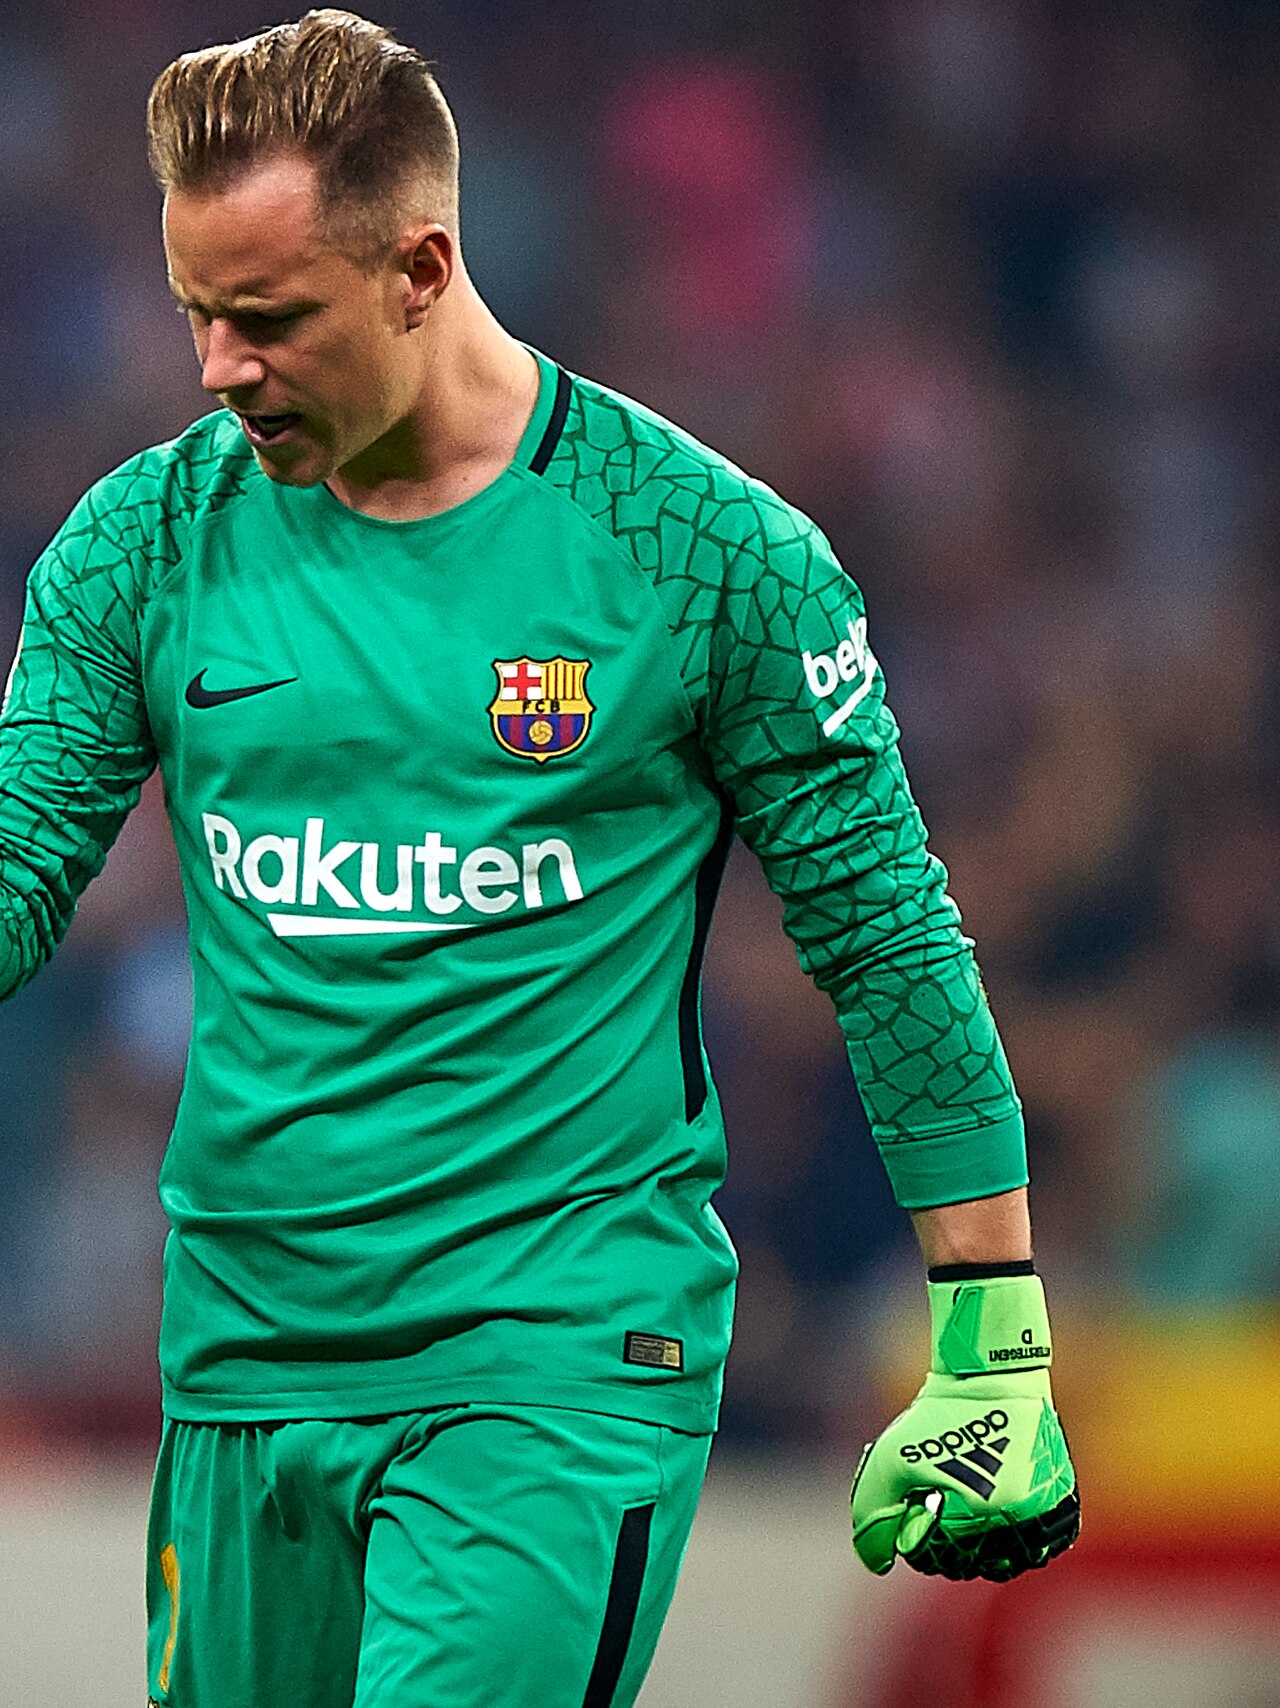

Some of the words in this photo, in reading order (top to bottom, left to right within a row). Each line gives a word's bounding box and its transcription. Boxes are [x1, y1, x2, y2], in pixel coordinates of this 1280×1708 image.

[522, 700, 561, 713] FCB
[202, 812, 584, 915] Rakuten
[1021, 1328, 1033, 1345] D
[900, 1409, 1009, 1463] adidas
